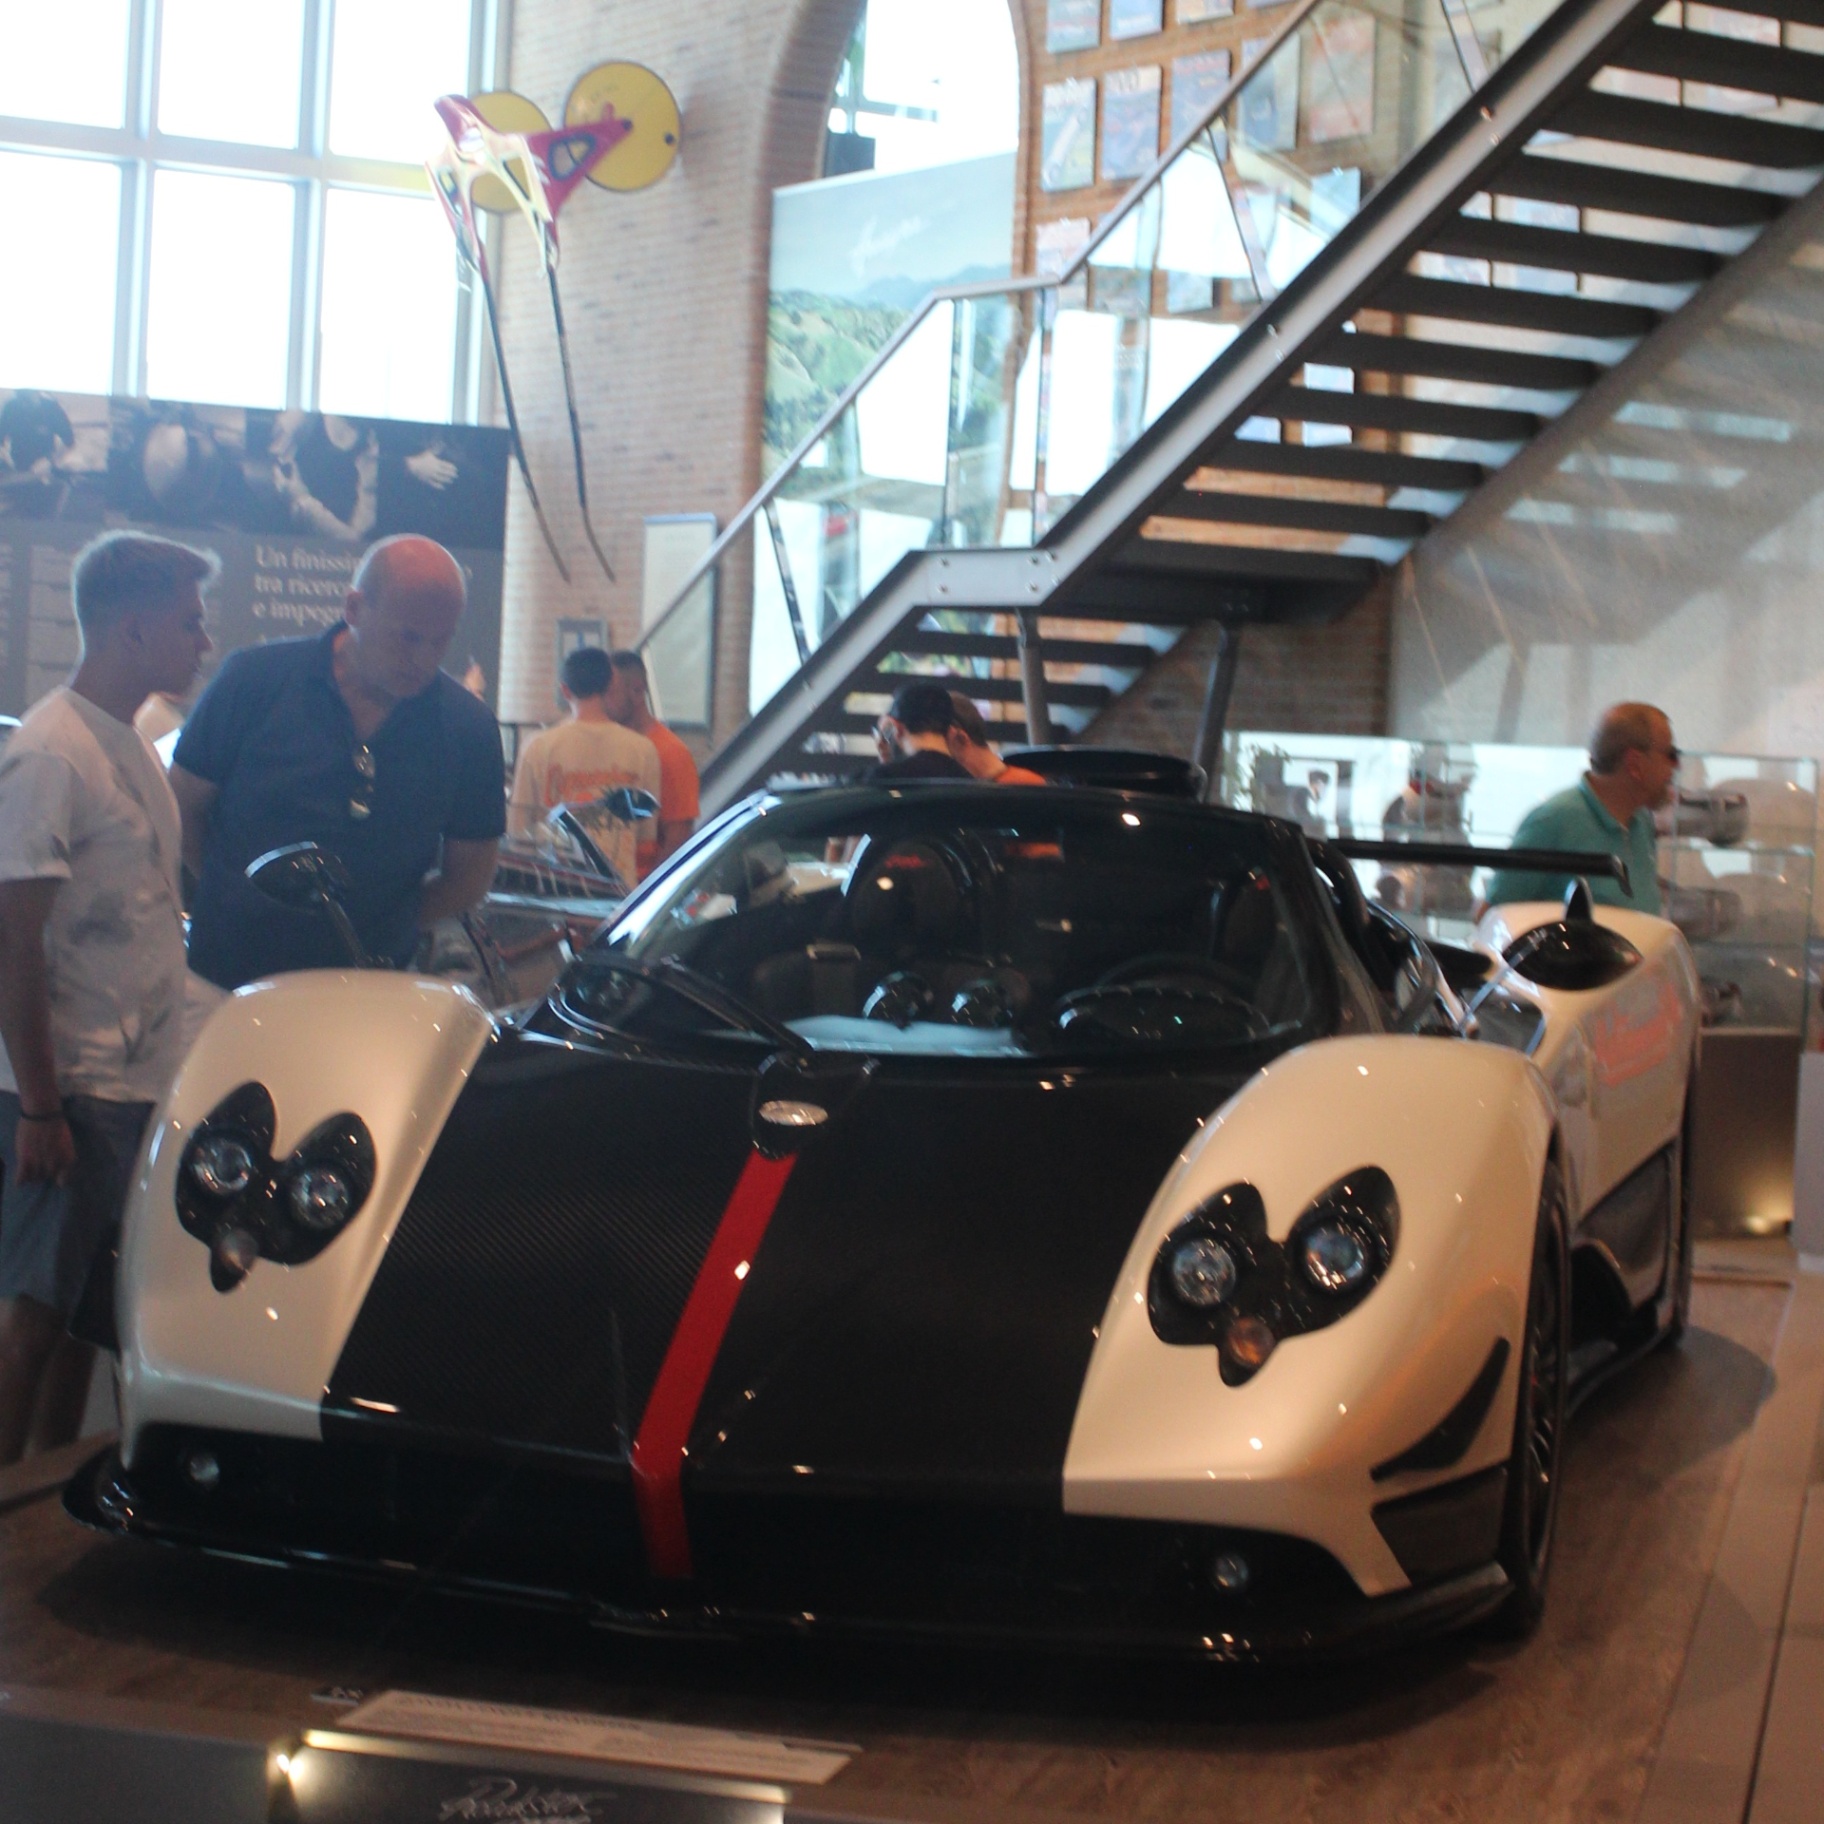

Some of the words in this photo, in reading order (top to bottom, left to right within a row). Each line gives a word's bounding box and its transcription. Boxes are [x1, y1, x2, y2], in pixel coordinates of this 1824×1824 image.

[255, 544, 288, 569] Un
[291, 546, 361, 571] finissi
[254, 573, 283, 594] tra
[287, 573, 350, 597] ricerc
[251, 601, 266, 619] e
[269, 597, 347, 627] impegn
